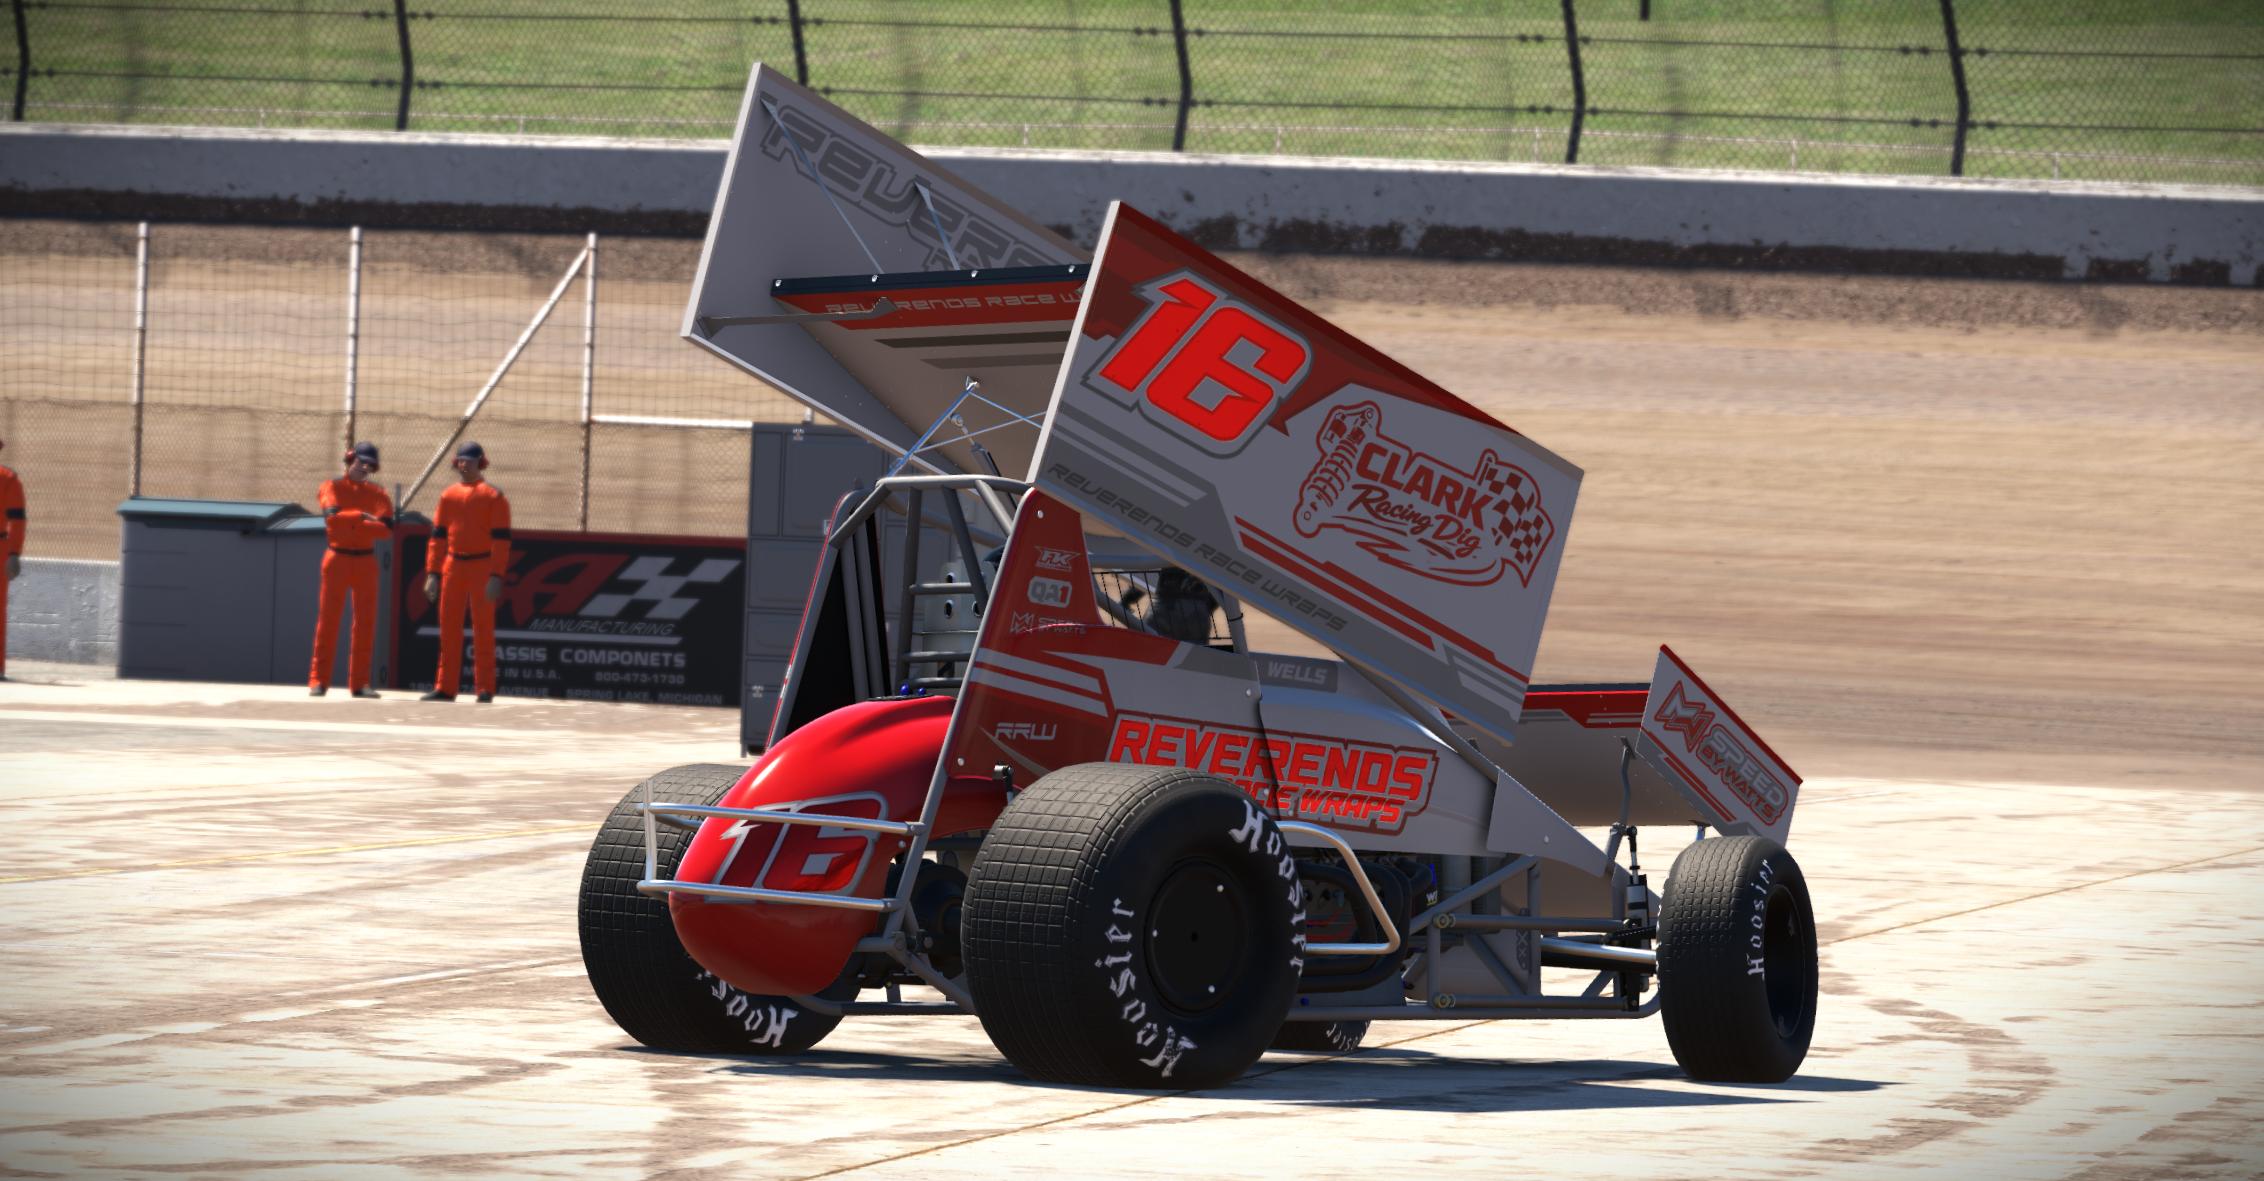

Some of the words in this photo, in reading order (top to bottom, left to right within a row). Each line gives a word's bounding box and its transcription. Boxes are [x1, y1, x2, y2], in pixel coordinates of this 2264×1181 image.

[825, 297, 982, 314] REVRENDS
[1095, 274, 1310, 444] 16
[1351, 483, 1438, 537] Racing
[1434, 515, 1481, 557] Dig
[1355, 440, 1497, 531] CLARK
[528, 618, 676, 636] MANUFACTURING
[1030, 581, 1070, 604] QA1
[466, 645, 548, 663] CASSIS
[560, 648, 687, 668] COMPONETS
[1266, 660, 1329, 685] WELLS
[1108, 718, 1430, 802] REVERENDS
[1710, 729, 1784, 806] SPEED
[1299, 790, 1405, 823] WRAPS
[714, 793, 888, 904] 16
[1747, 858, 1774, 982] Hoosier
[1095, 897, 1198, 1078] Hoosier
